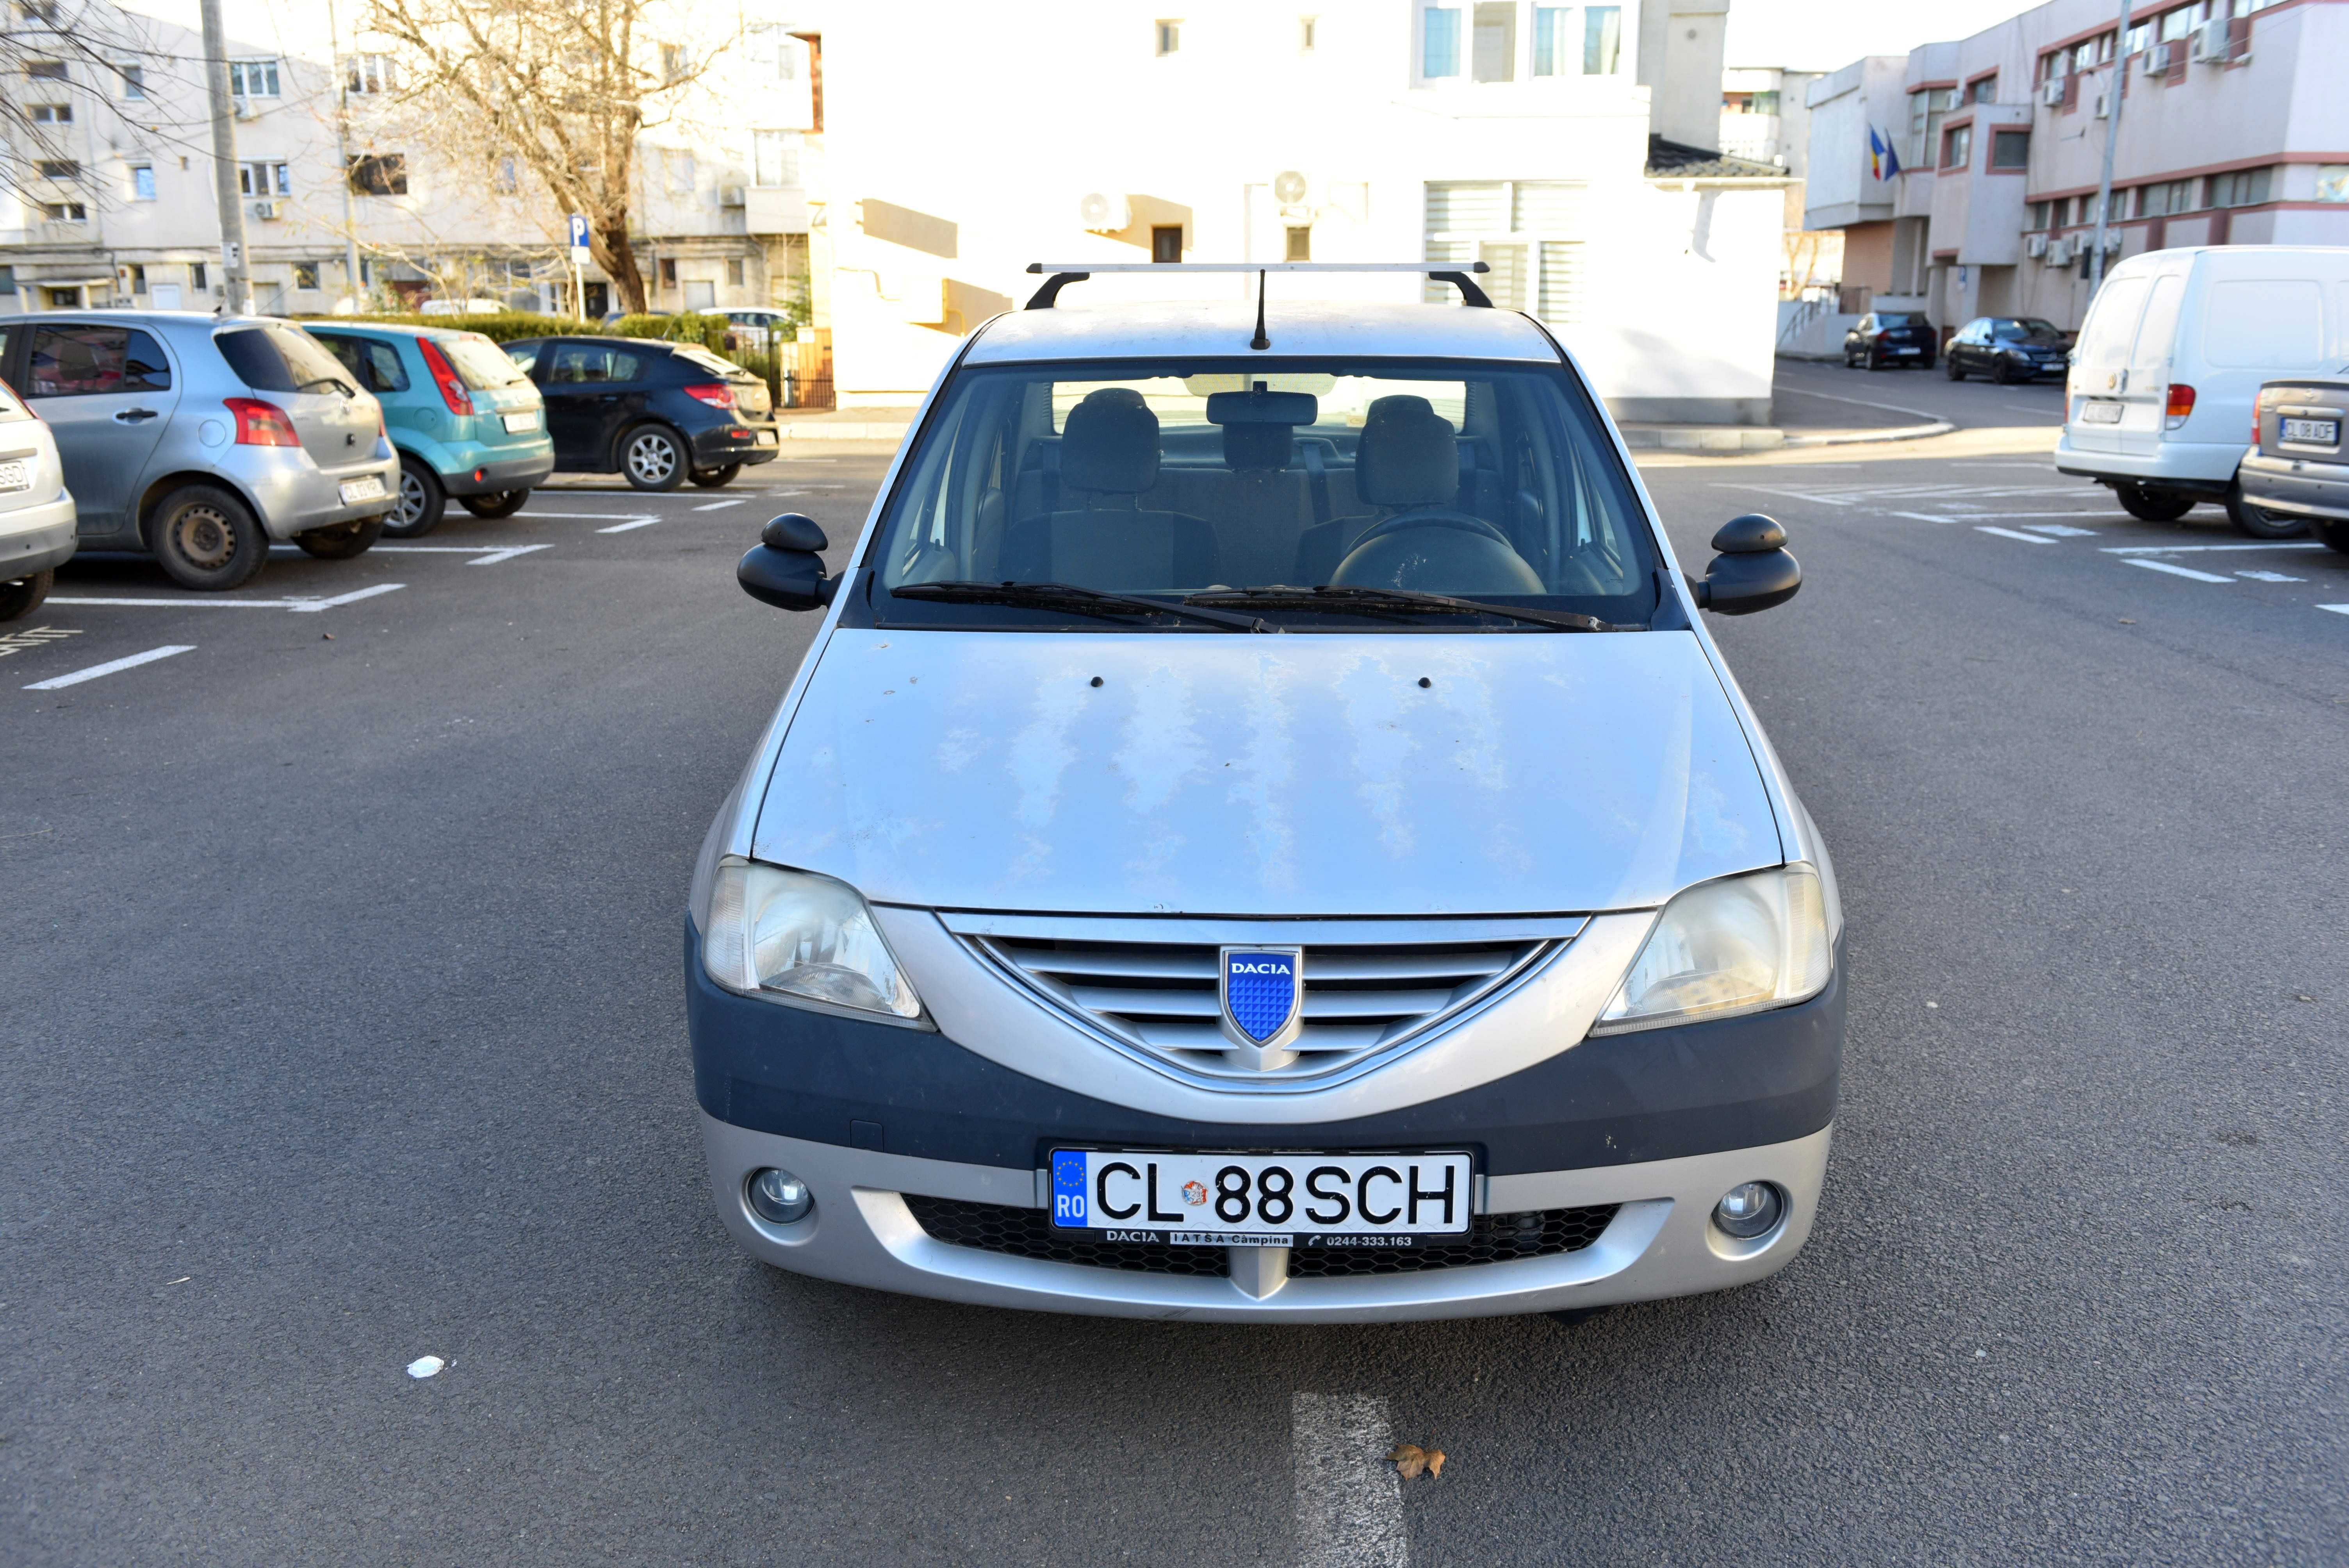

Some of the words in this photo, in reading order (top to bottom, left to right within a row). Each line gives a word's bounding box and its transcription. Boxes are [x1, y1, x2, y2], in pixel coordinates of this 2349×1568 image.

[572, 217, 585, 246] P
[1231, 963, 1291, 975] DACIA
[1097, 1162, 1184, 1222] CL
[1057, 1194, 1085, 1217] RO
[1107, 1230, 1160, 1242] DACIA
[1232, 1235, 1289, 1246] Câmpina
[1326, 1237, 1412, 1246] 0244-333.163
